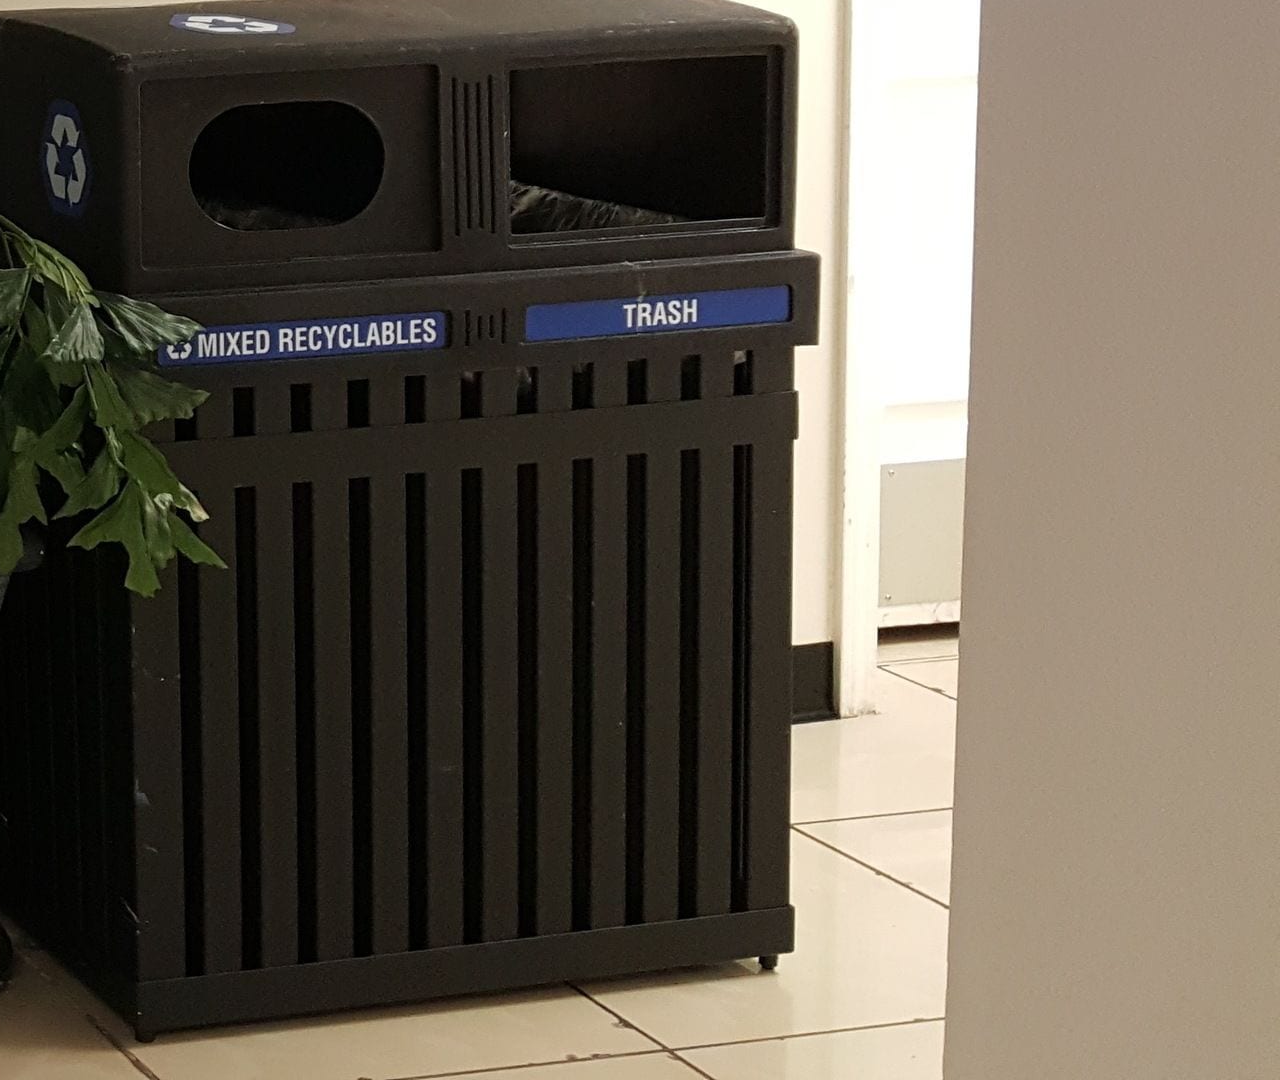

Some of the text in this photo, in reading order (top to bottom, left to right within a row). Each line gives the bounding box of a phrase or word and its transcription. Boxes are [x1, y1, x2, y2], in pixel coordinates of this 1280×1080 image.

[623, 298, 699, 328] TRASH
[197, 318, 438, 359] MIXED RECYCLABLES
